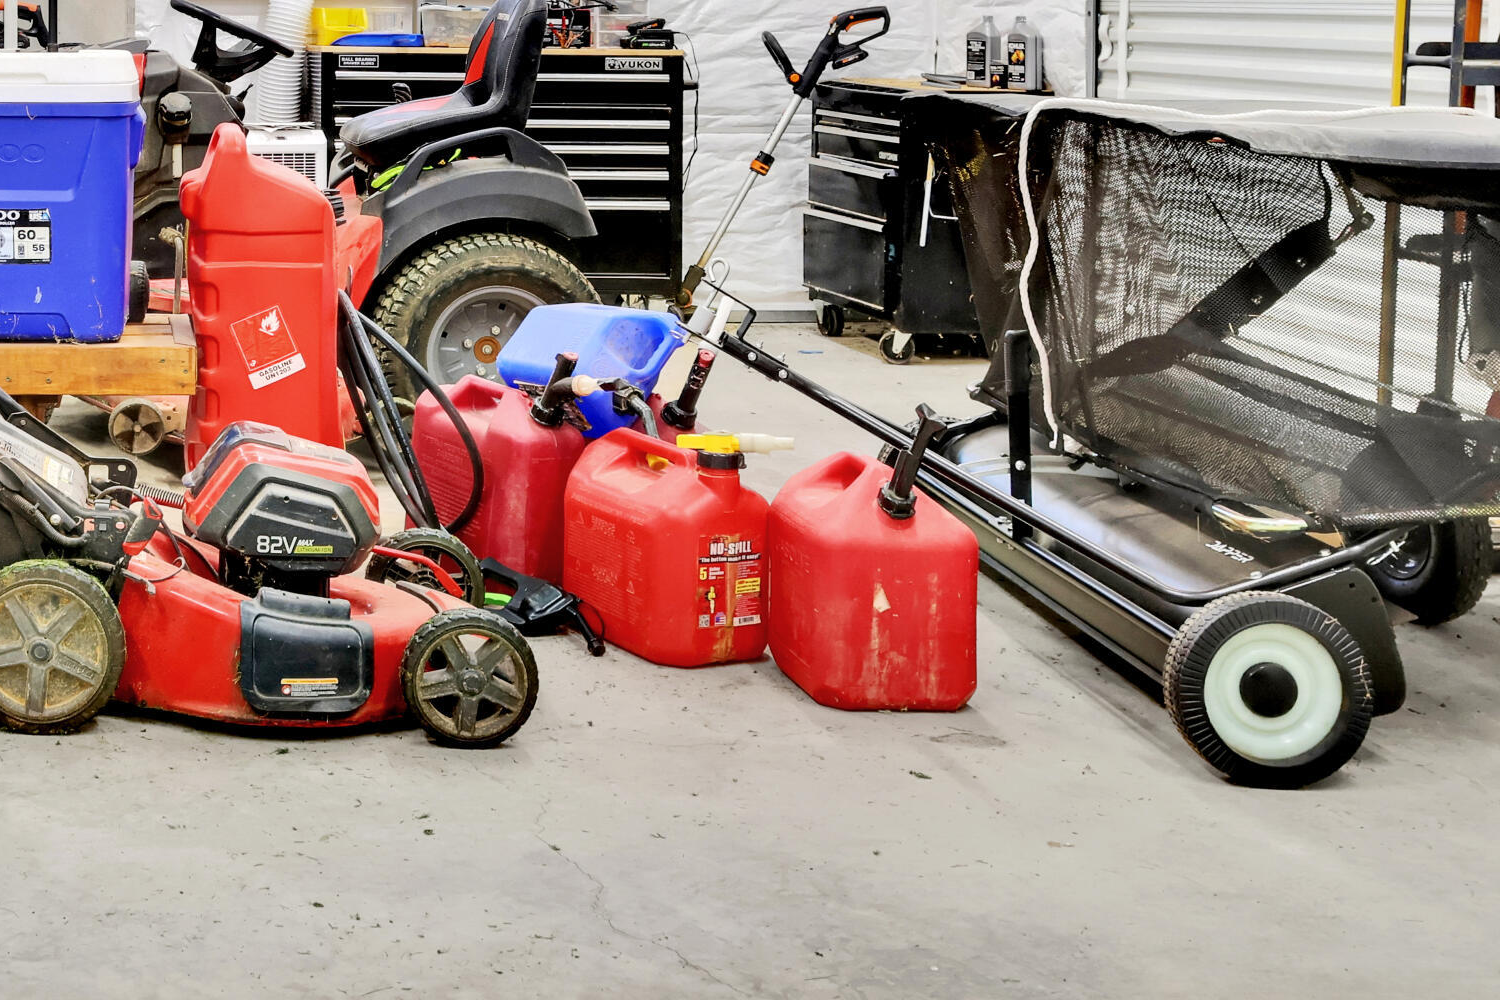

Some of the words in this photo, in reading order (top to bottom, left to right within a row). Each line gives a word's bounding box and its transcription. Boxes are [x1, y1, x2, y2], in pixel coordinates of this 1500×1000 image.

[619, 61, 660, 69] YUKON
[17, 229, 36, 240] 60
[32, 244, 45, 252] 56
[259, 359, 293, 377] GASOLINE
[265, 366, 291, 380] UN1203
[256, 535, 297, 554] 82V
[710, 541, 751, 555] NO-SPILL
[700, 567, 707, 580] 5
